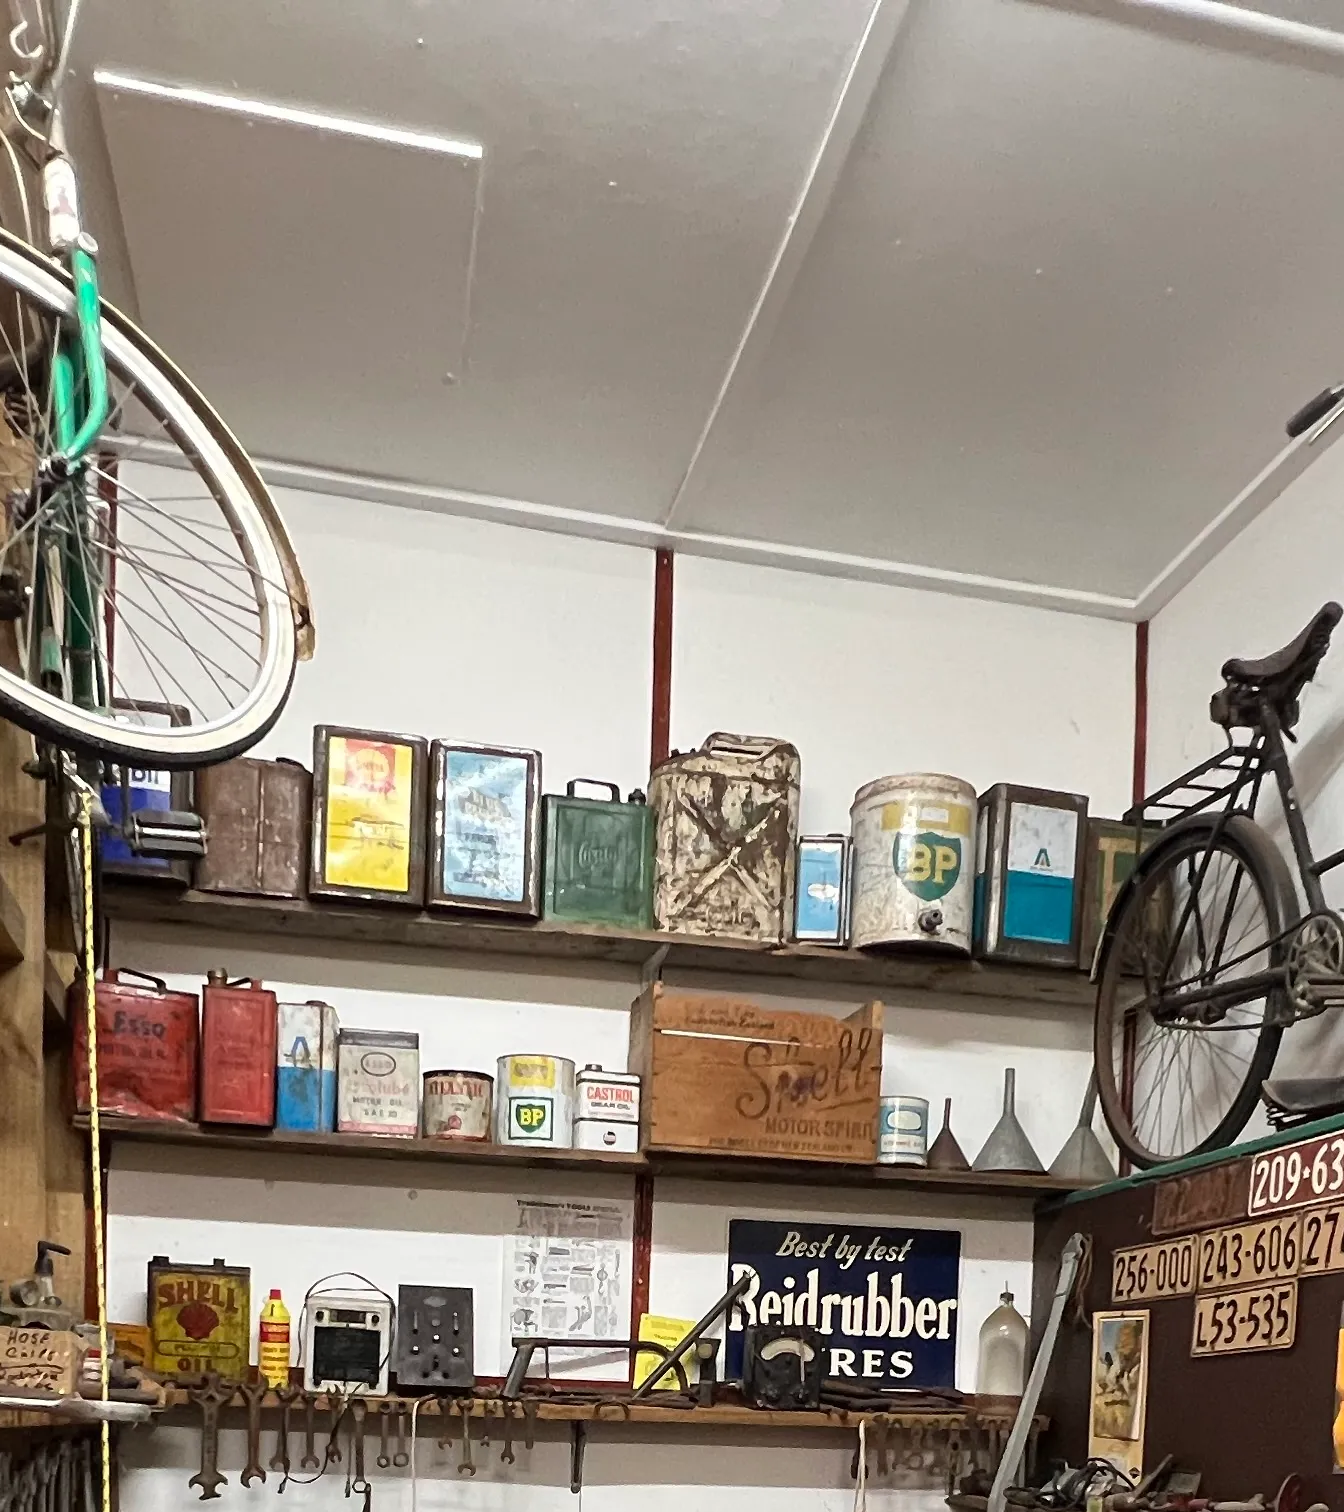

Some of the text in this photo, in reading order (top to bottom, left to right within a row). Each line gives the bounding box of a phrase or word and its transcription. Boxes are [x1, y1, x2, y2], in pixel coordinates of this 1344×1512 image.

[902, 842, 957, 884] BP
[114, 1010, 166, 1039] Esso
[586, 1086, 635, 1104] CASTROL
[518, 1108, 544, 1127] BP
[765, 1116, 821, 1137] MOTOR
[775, 1231, 915, 1270] Best by test
[1203, 1225, 1298, 1282] 243-606
[1115, 1245, 1193, 1297] 256-000
[158, 1280, 239, 1314] SHELL
[728, 1262, 958, 1341] Reidrubber
[1197, 1291, 1291, 1347] L53-535
[177, 1357, 214, 1373] OIL
[822, 1347, 914, 1379] RES
